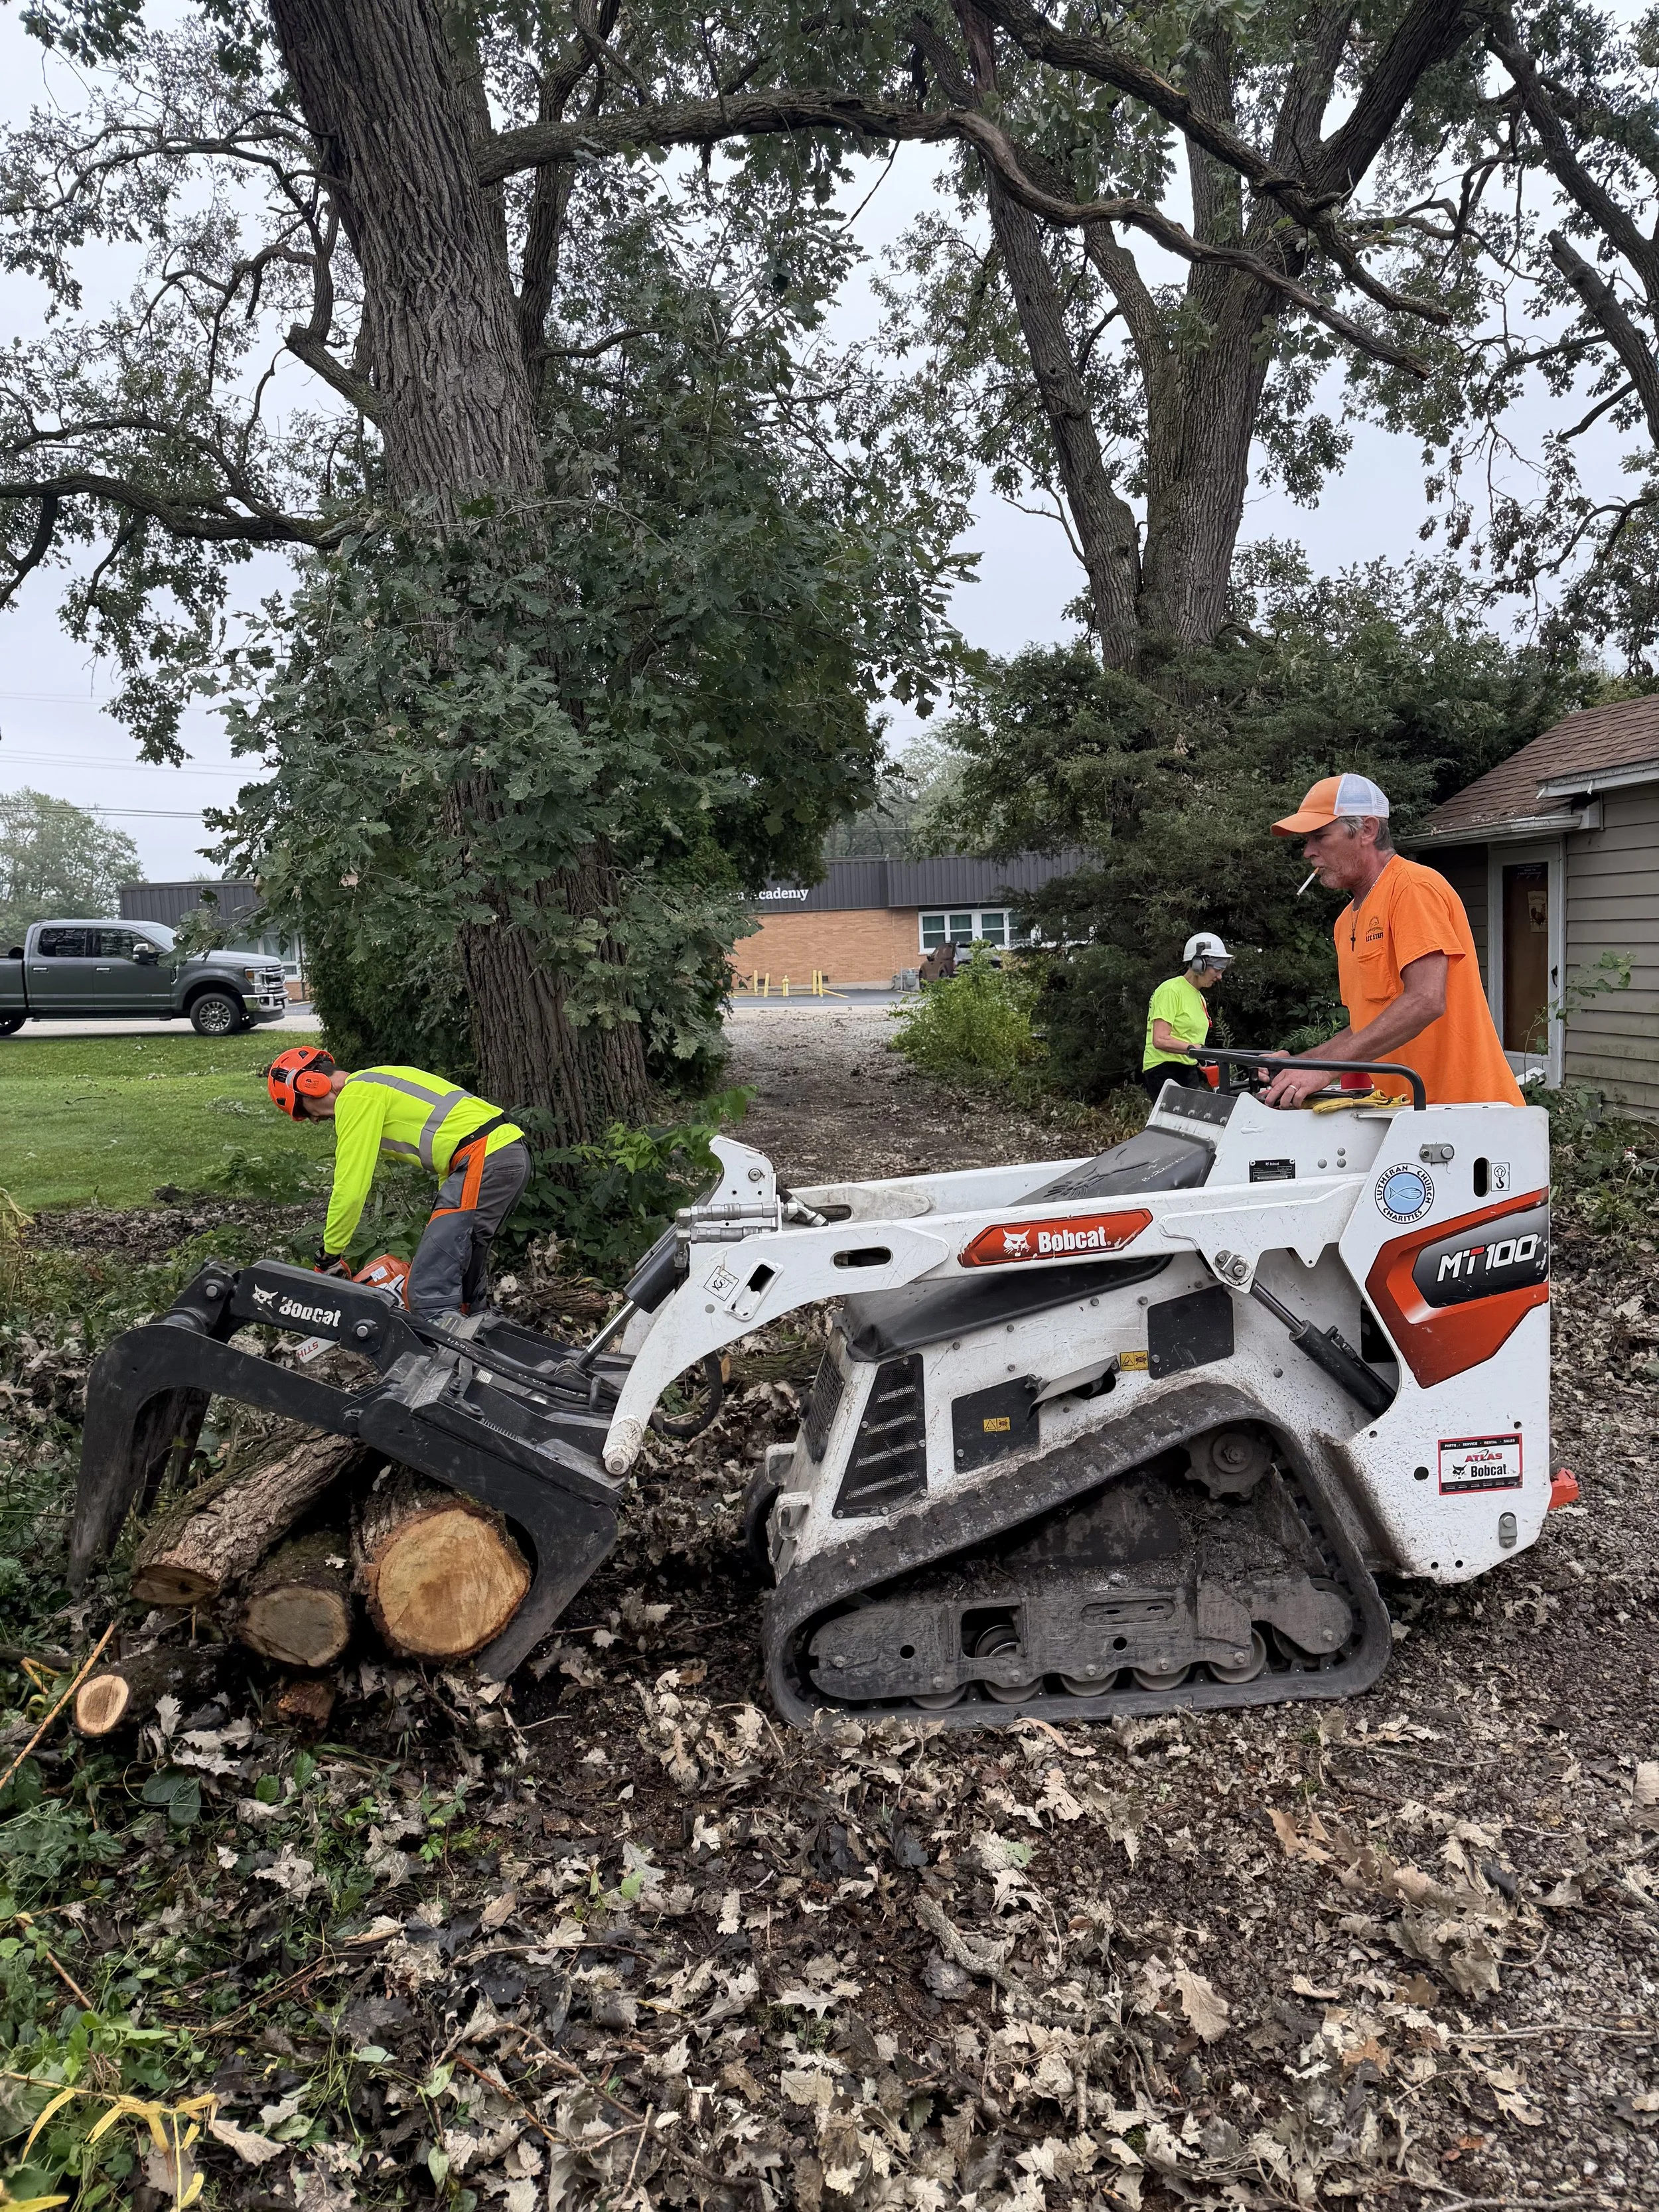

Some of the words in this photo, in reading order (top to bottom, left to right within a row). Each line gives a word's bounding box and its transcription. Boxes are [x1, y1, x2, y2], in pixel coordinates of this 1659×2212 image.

[1377, 1165, 1408, 1201] LUTHERAN
[1417, 1170, 1432, 1204] CHURCH
[1383, 1208, 1423, 1221] CHARITIES
[1038, 1226, 1107, 1253] Bobcat
[1437, 1232, 1540, 1282] MT100
[1465, 1453, 1502, 1463] ATLAS
[1471, 1463, 1506, 1478] Bobcat
